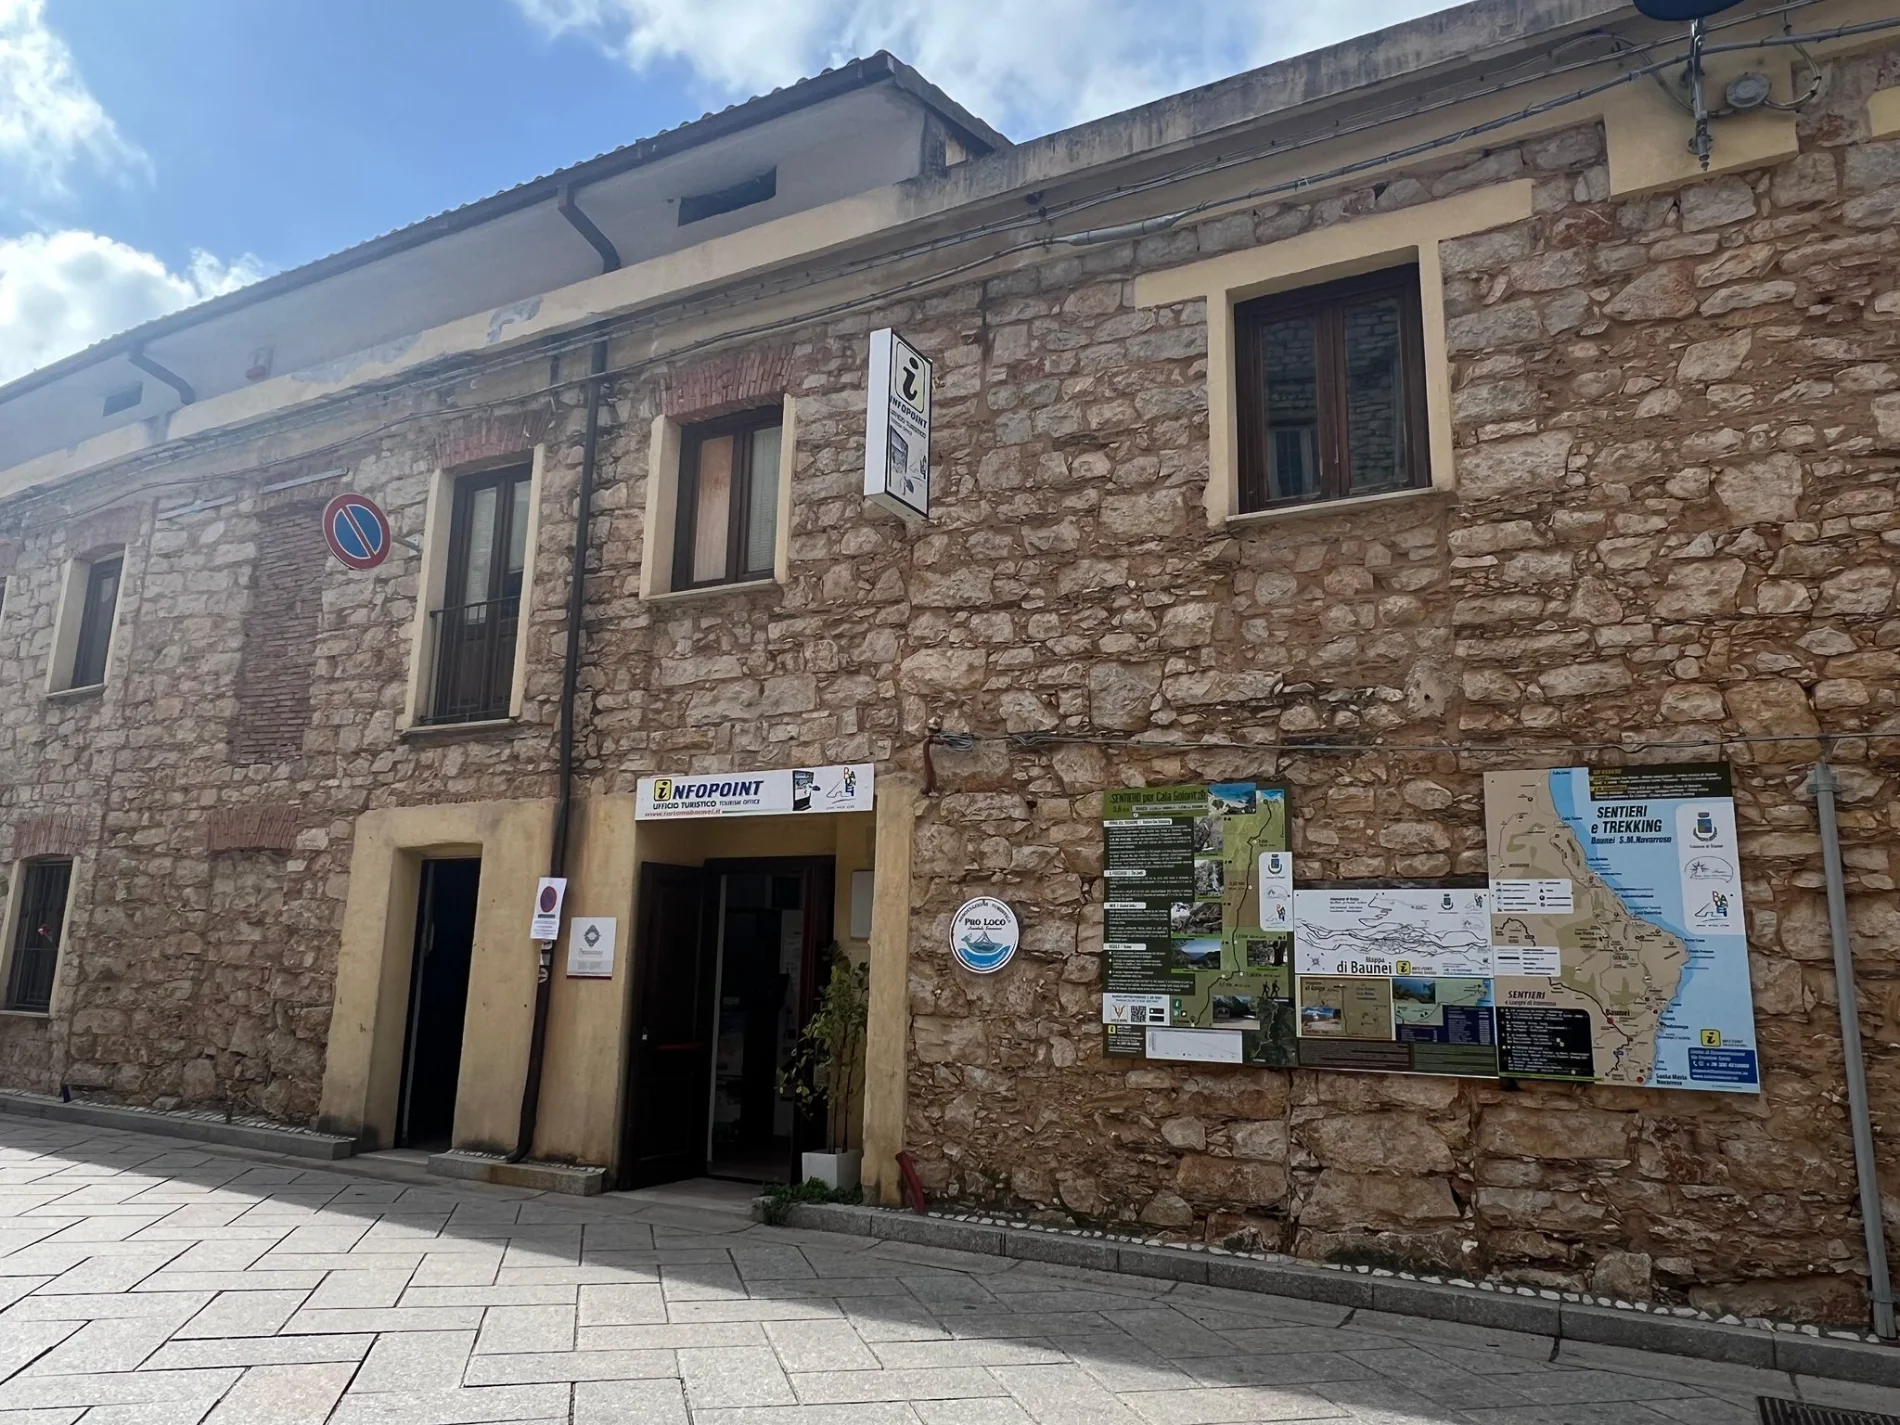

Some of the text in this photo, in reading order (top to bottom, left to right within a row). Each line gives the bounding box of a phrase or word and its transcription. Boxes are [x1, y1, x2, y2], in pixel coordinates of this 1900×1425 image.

[653, 802, 680, 810] UFFICIO
[681, 800, 717, 809] TURISTICO
[1597, 805, 1648, 819] SENTIERI
[1591, 819, 1663, 834] e TREKKING
[1365, 956, 1386, 964] Mappa
[1336, 961, 1393, 975] di Baunei
[1508, 990, 1546, 1000] SENTIERI
